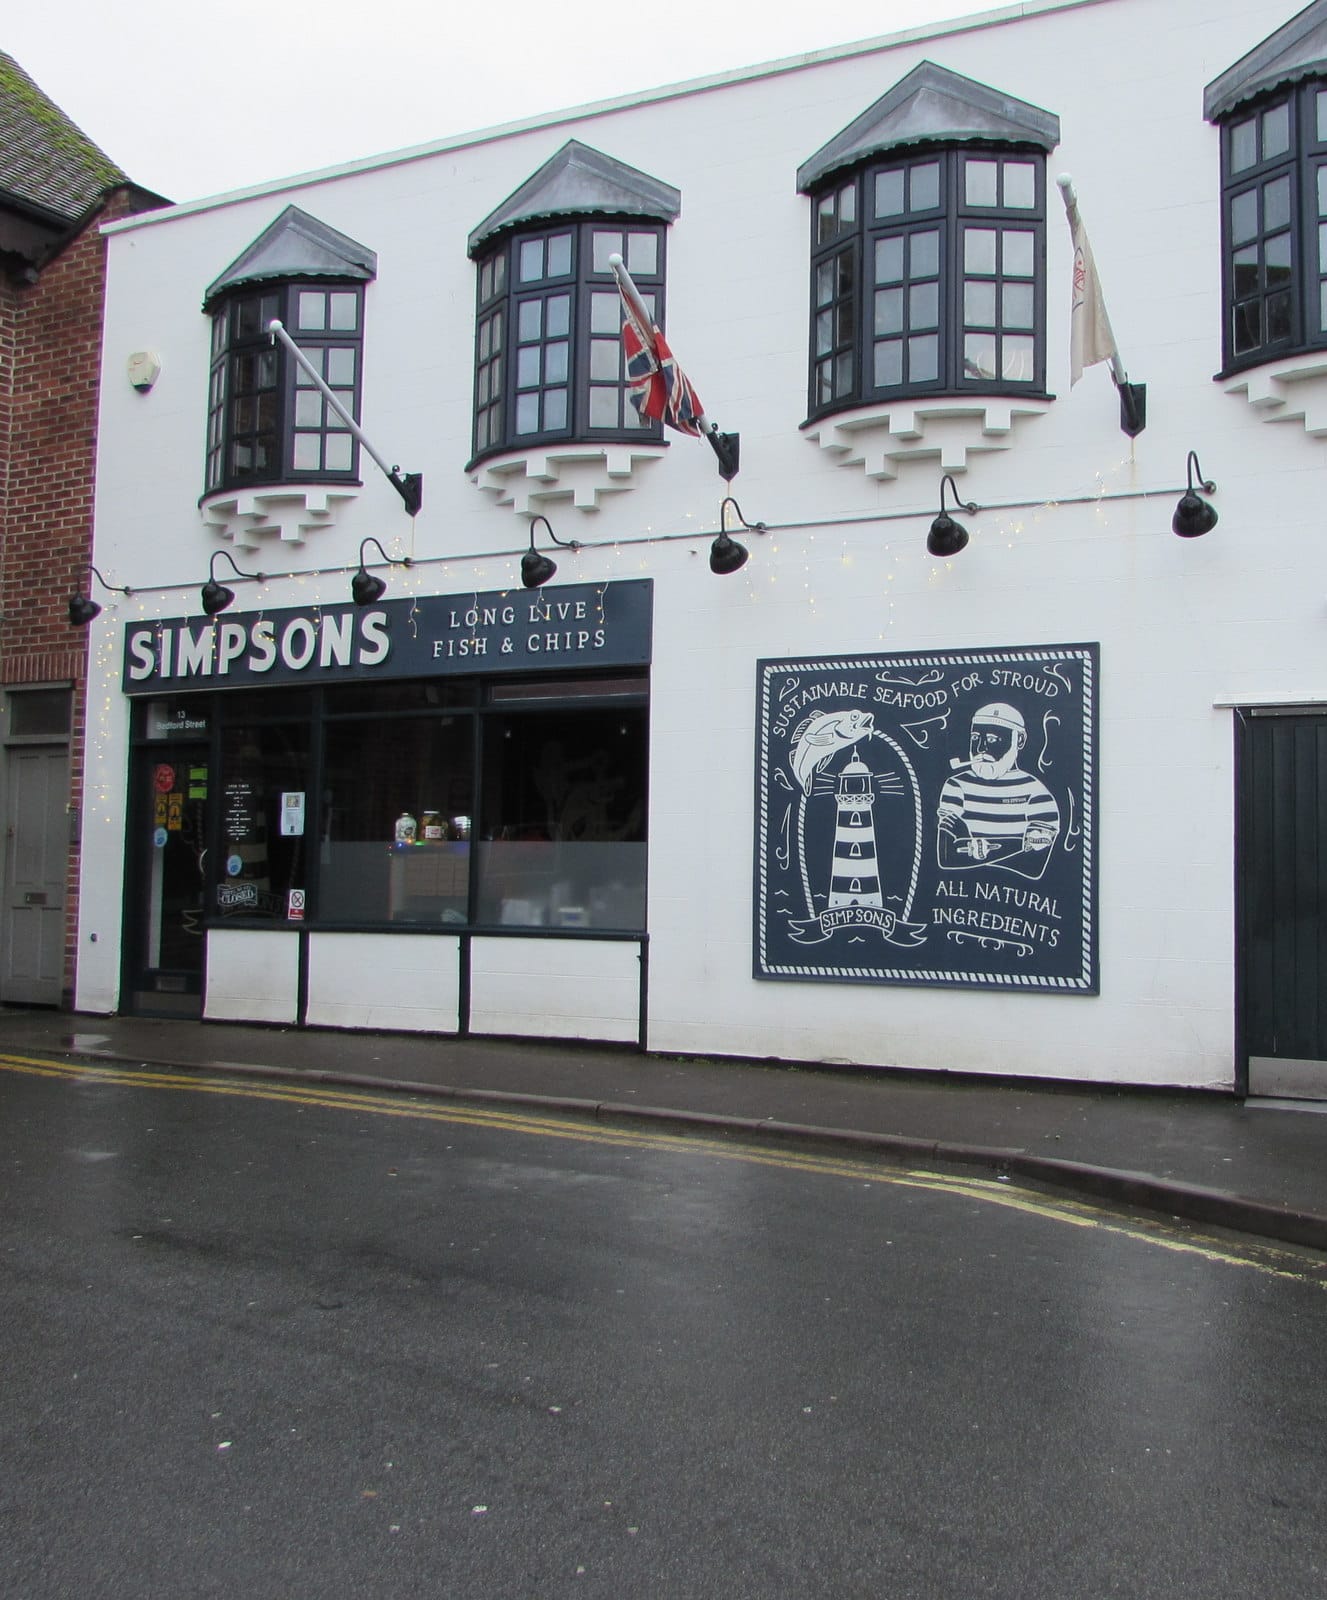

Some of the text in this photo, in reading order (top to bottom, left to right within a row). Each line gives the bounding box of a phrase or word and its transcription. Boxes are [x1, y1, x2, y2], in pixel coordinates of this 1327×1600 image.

[450, 601, 586, 628] LONG LIVE
[130, 611, 390, 681] SIMPSONS
[432, 630, 606, 658] FISH & CHIPS
[177, 710, 186, 719] 13
[772, 669, 1059, 738] SUSTAINABLE SEAFOOD FOR STROUD
[184, 719, 206, 729] Street
[935, 880, 1062, 919] ALL NATURAL
[822, 909, 893, 929] SIMPSONS
[932, 907, 1060, 947] INGREDIENTS
